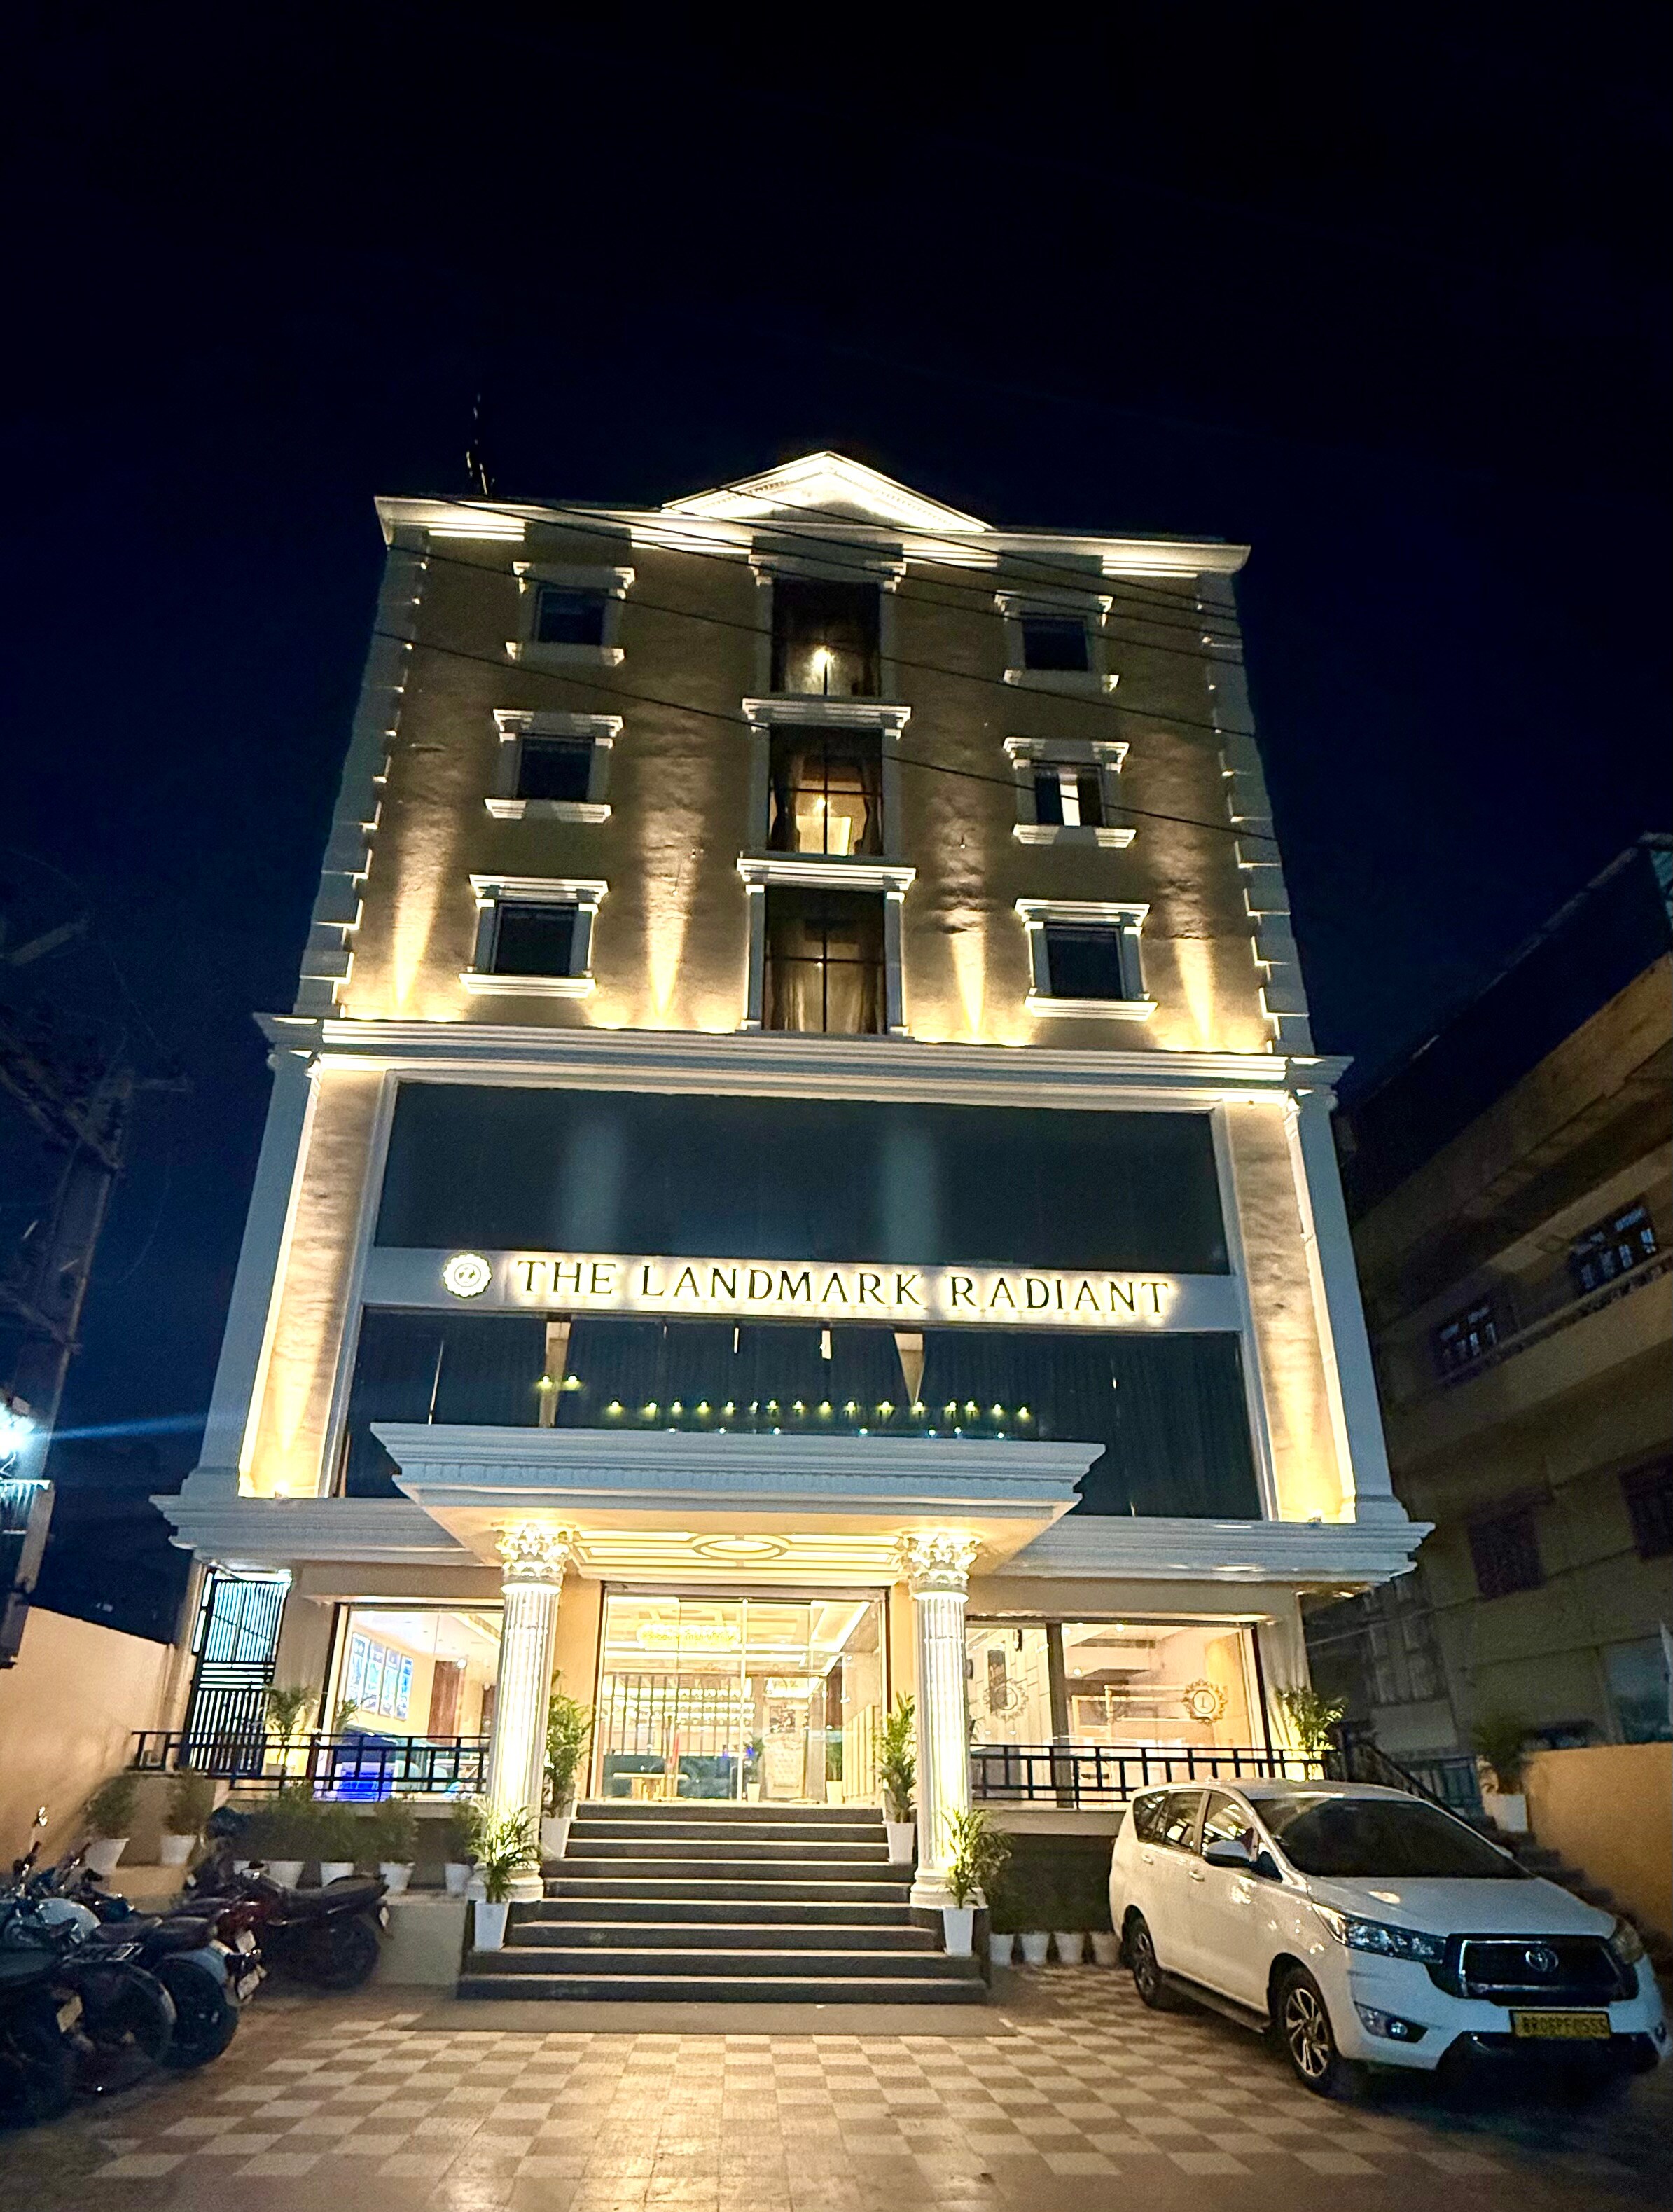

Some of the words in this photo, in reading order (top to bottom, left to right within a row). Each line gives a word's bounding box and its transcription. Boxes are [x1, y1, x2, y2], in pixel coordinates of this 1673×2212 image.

[517, 1260, 618, 1295] THE
[640, 1264, 926, 1306] LANDMARK
[950, 1276, 1169, 1314] RADIANT
